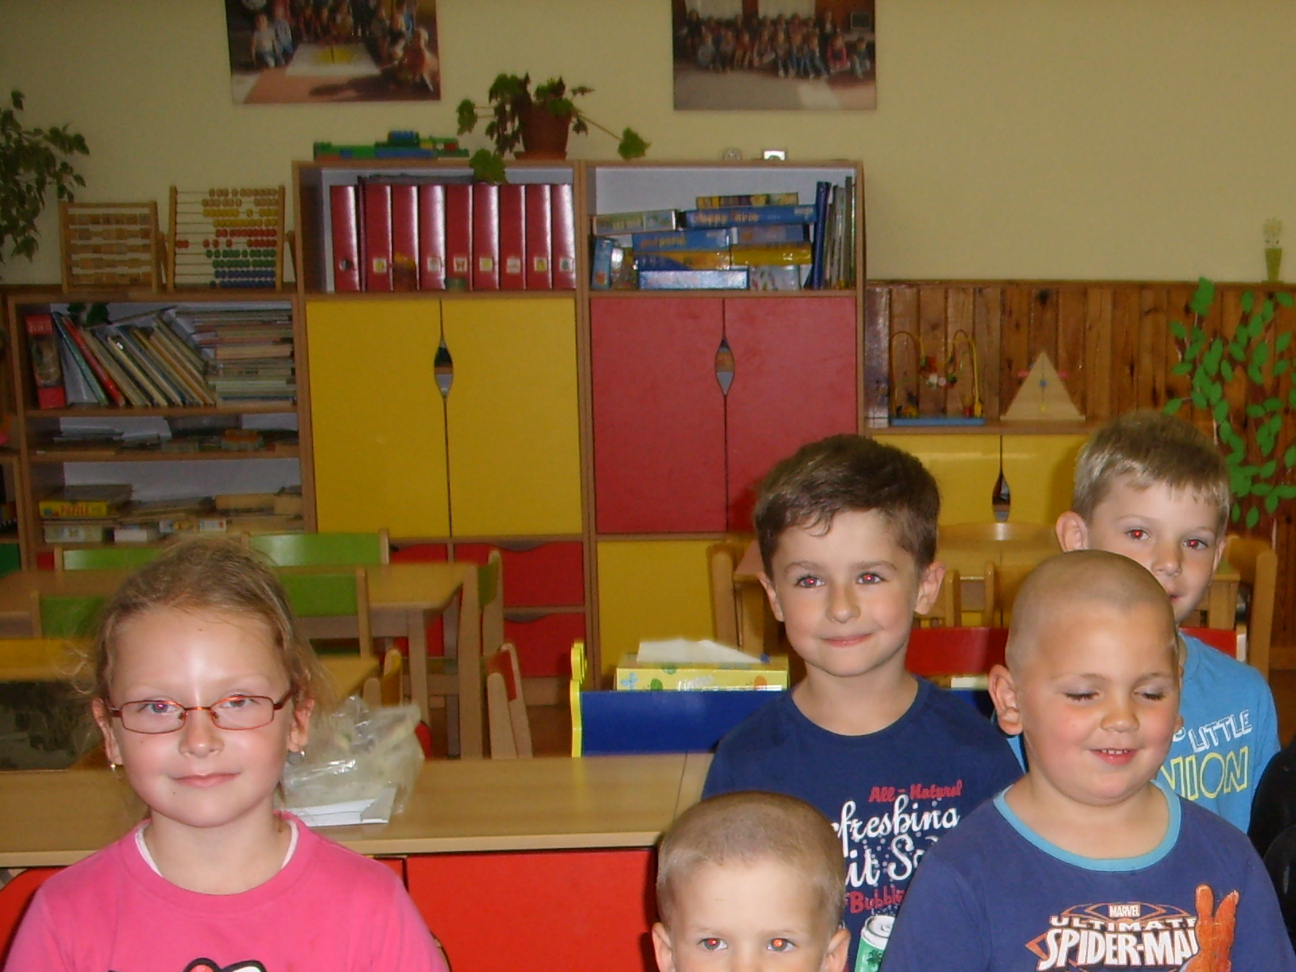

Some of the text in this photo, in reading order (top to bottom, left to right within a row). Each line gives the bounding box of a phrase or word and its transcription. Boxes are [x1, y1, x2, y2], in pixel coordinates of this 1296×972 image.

[1188, 709, 1253, 753] LITTLE
[869, 786, 897, 803] All
[910, 779, 963, 800] Natural
[1109, 904, 1141, 918] MARVEL
